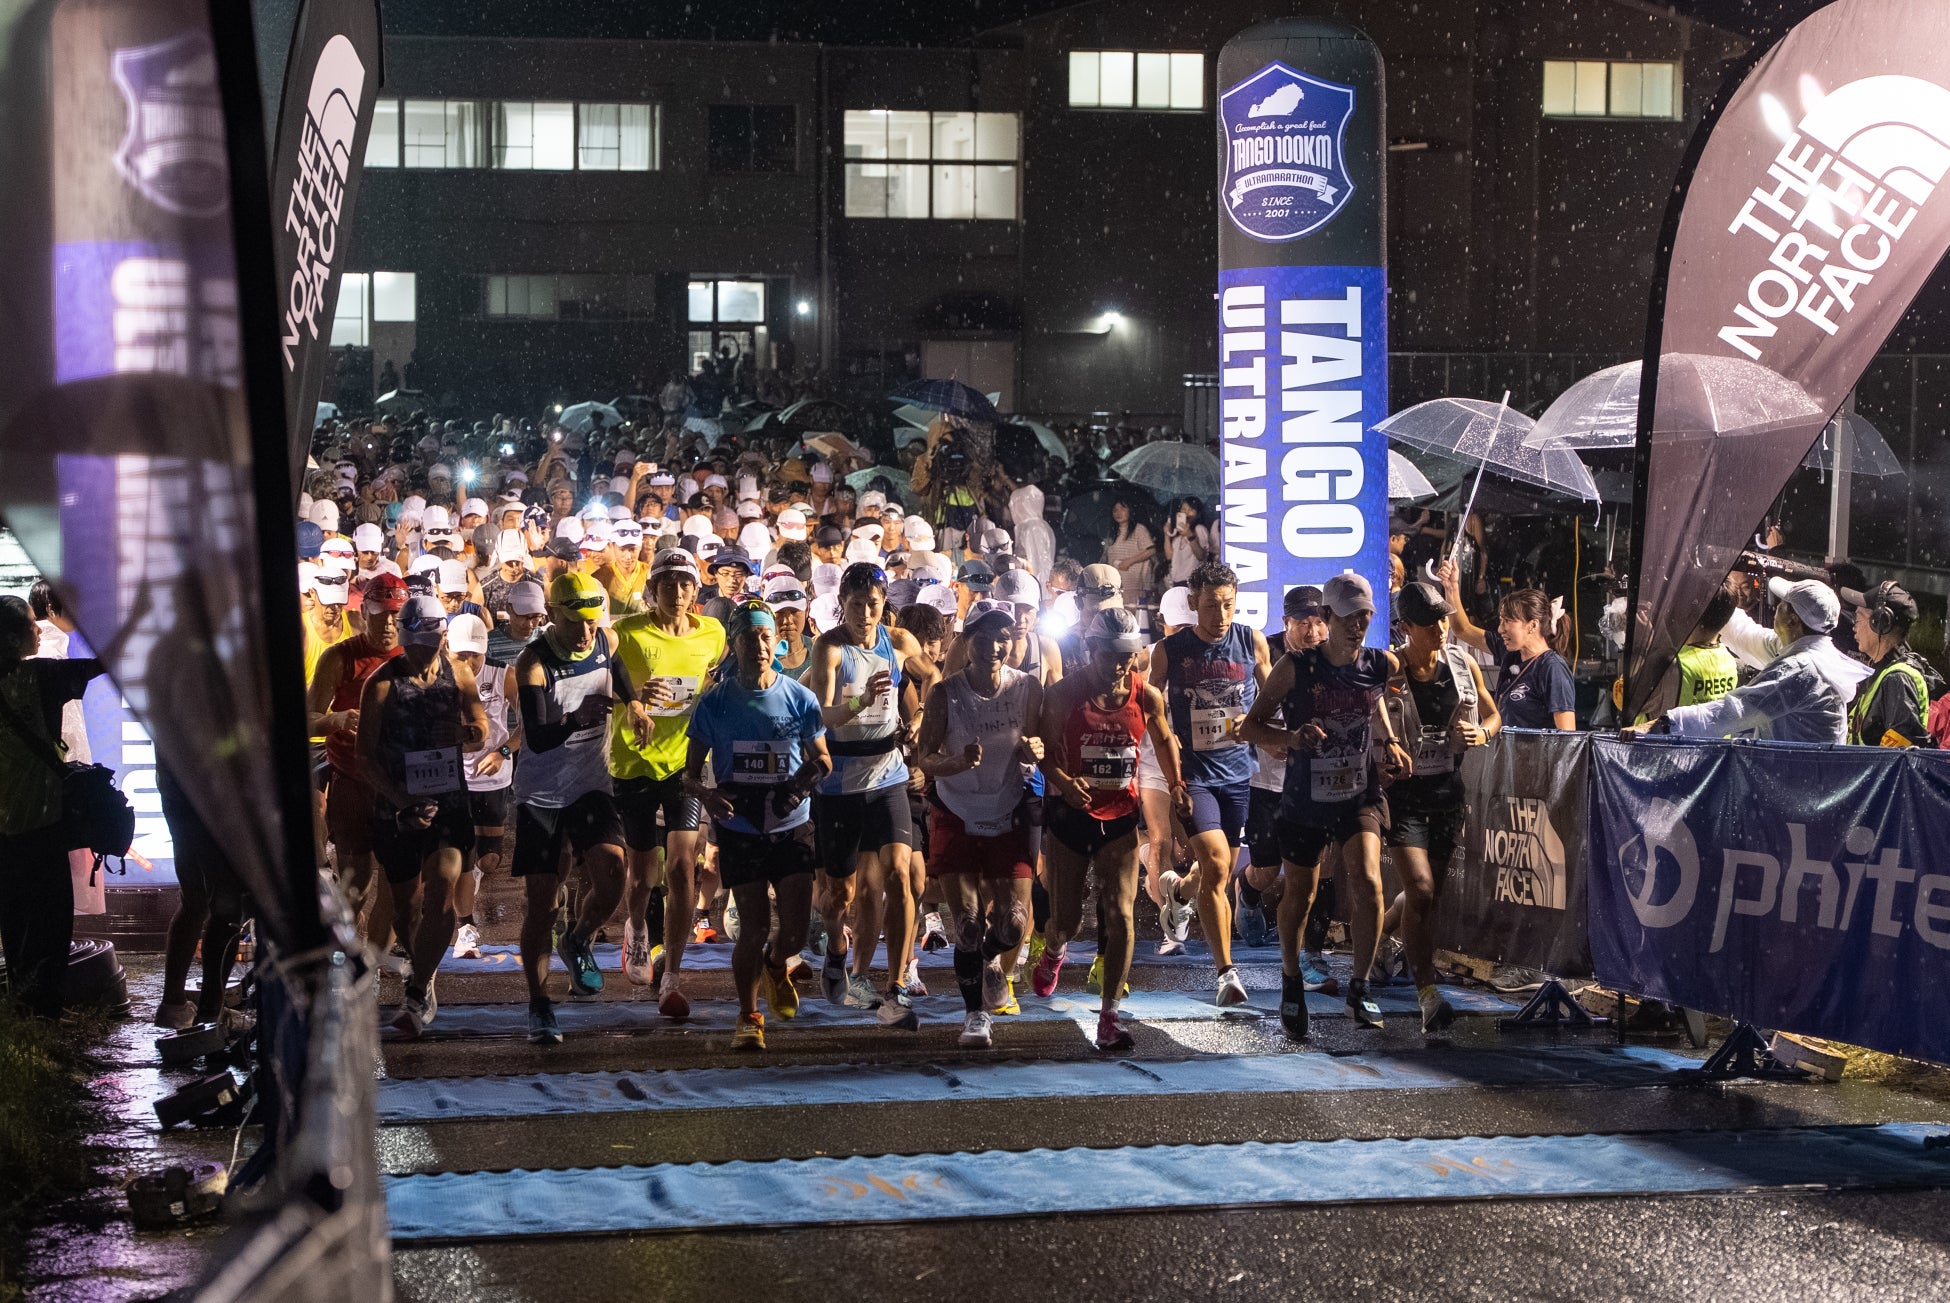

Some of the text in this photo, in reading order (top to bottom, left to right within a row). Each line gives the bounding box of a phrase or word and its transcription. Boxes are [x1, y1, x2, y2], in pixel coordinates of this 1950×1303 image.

[1235, 120, 1276, 133] Accomplish
[1284, 120, 1308, 133] great
[1308, 120, 1327, 131] feat
[1232, 134, 1332, 173] TANGO 100KM
[285, 113, 319, 238] THE
[1244, 173, 1314, 188] ULTRAMARATHON
[1727, 132, 1834, 244] THE
[1261, 196, 1294, 206] SINCE
[1265, 209, 1290, 218] 2001
[281, 138, 331, 373] NORTH
[304, 166, 344, 341] FACE
[1717, 159, 1876, 361] NORTH
[1795, 186, 1919, 336] FACE
[1280, 286, 1364, 558] TANGO
[1693, 676, 1733, 696] PRESS
[1199, 725, 1222, 735] 1141
[744, 759, 764, 769] 140
[1092, 764, 1112, 774] 162
[1506, 796, 1539, 834] THE
[1483, 829, 1534, 870] NORTH
[1495, 866, 1535, 906] FACE
[1708, 821, 1950, 953] phite
